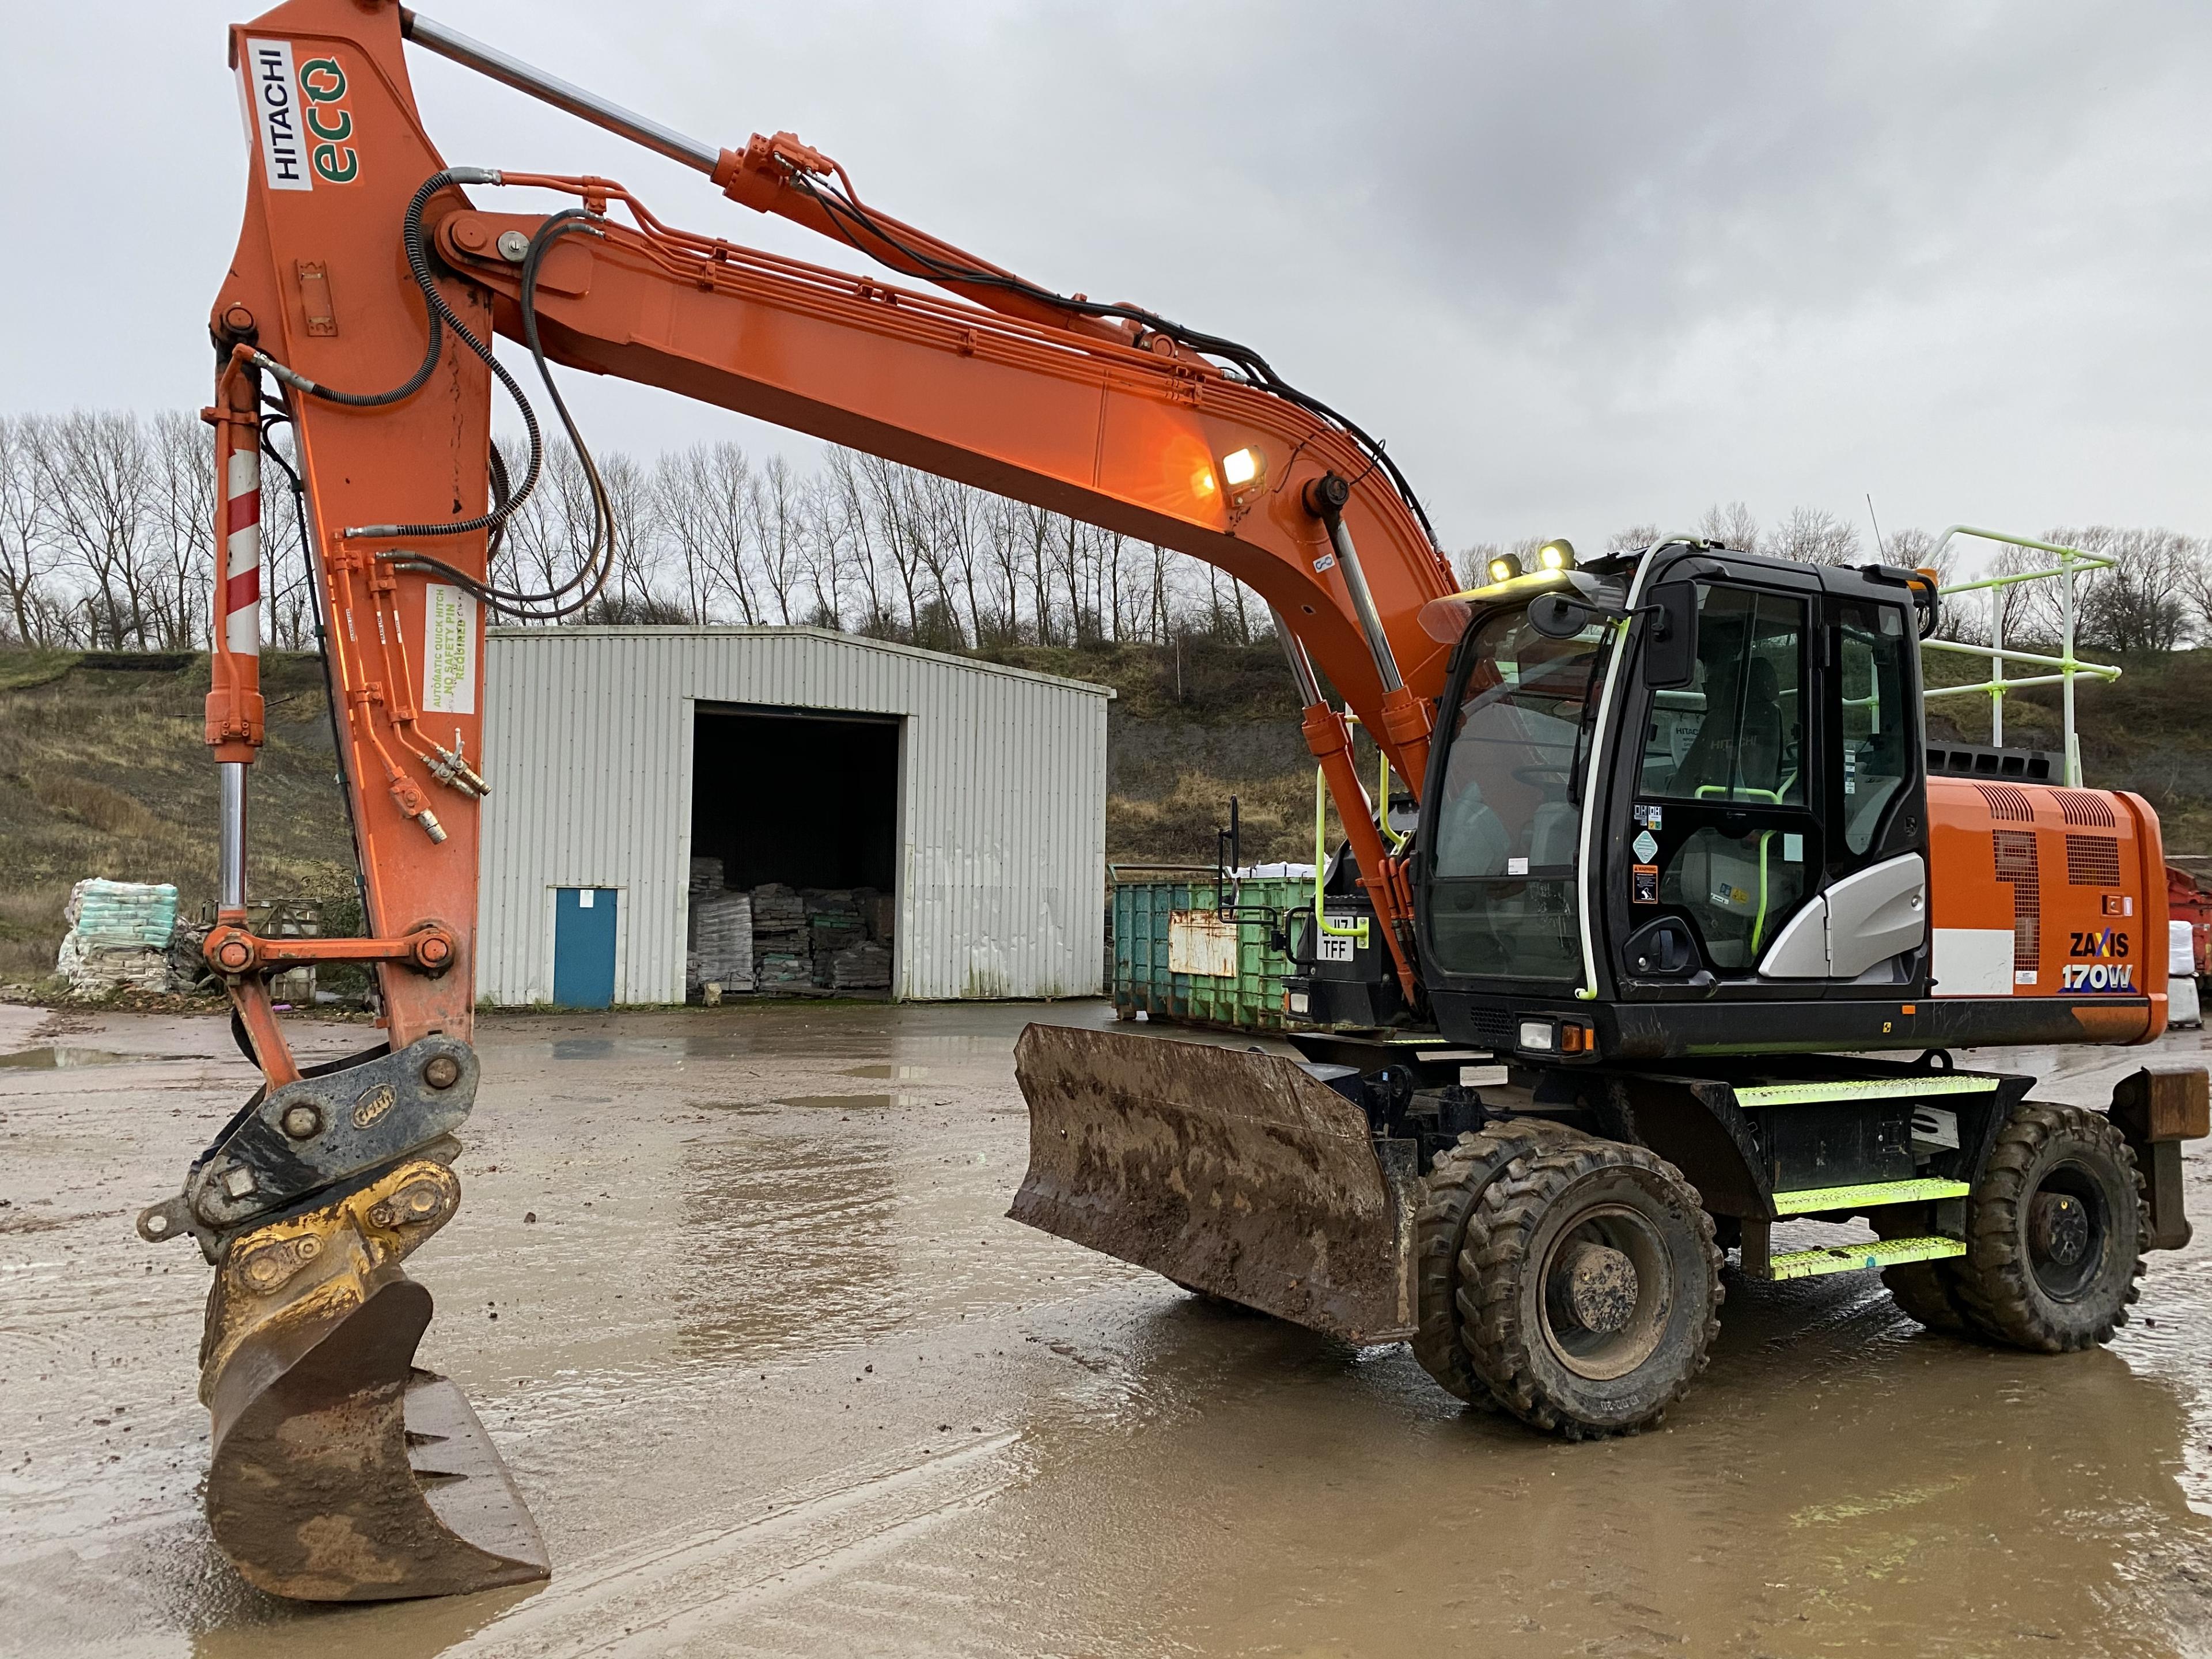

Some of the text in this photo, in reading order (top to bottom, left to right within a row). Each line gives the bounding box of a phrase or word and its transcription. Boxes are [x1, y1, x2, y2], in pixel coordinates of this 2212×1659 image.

[258, 49, 300, 180] HITACHI
[433, 589, 444, 707] AUTOMATIC QUICK HITCH
[444, 603, 455, 695] NO SAFETY PIN
[456, 620, 465, 680] REQUIRED
[1323, 940, 1346, 959] TFF
[2070, 928, 2128, 957] ZAXIS
[2062, 964, 2133, 989] 170W
